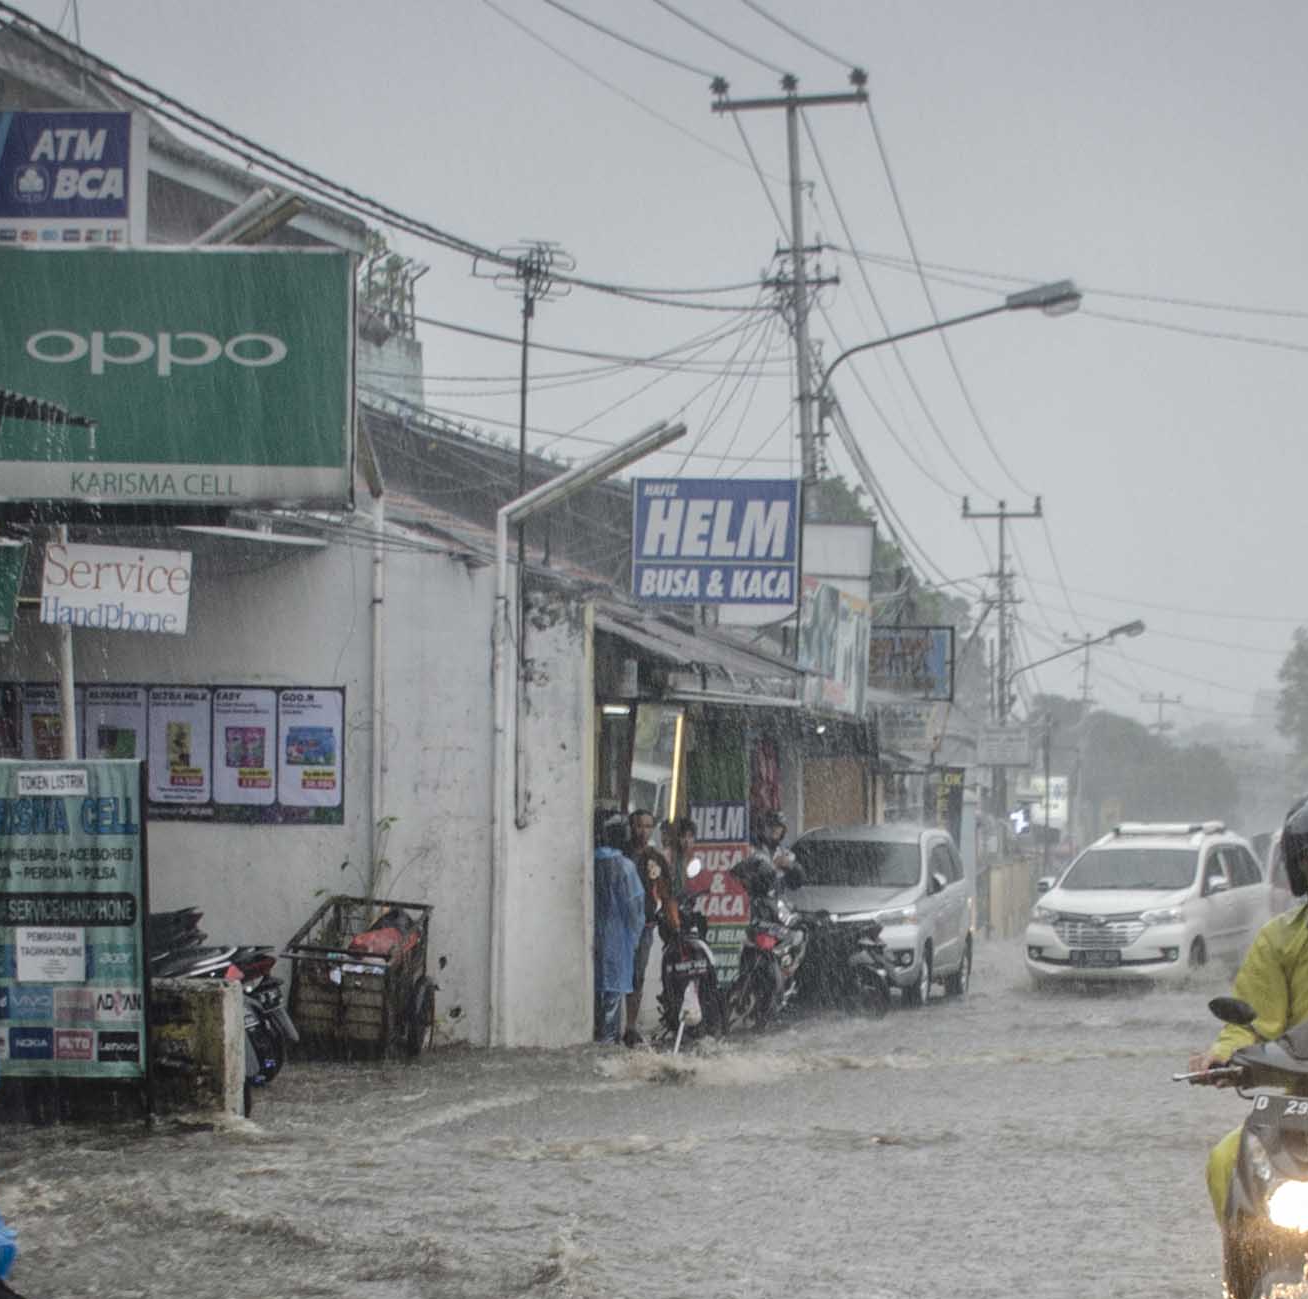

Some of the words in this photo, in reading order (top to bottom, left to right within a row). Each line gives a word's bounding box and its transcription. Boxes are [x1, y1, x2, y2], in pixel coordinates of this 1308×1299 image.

[29, 128, 108, 162] ATM
[53, 167, 124, 200] BCA
[26, 330, 288, 376] oppo
[70, 472, 176, 496] KARISMA
[183, 473, 240, 498] CELL
[642, 499, 790, 558] HELM
[46, 543, 191, 596] Service
[640, 569, 699, 598] BUSA
[705, 571, 725, 597] &
[729, 570, 791, 599] KACA
[216, 690, 242, 701] EASY
[20, 776, 47, 789] TOKEN
[81, 797, 138, 835] CELL
[693, 806, 744, 840] HELM
[711, 874, 726, 892] &
[693, 895, 744, 916] KACA
[16, 1039, 47, 1047] NOKIA
[1255, 1096, 1269, 1110] D
